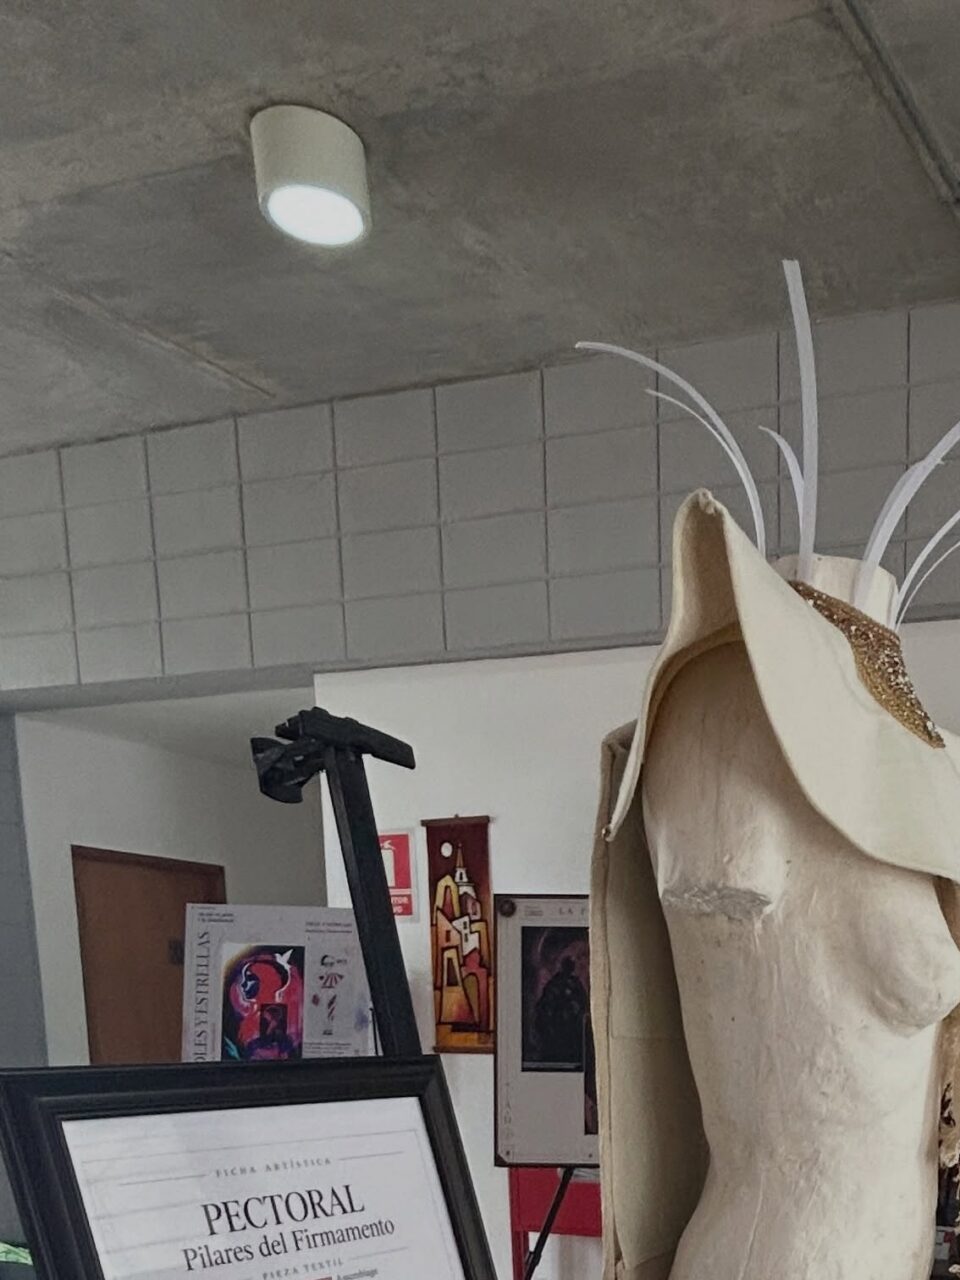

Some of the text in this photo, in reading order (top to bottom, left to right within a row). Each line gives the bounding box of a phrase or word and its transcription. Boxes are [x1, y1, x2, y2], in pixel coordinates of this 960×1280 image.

[215, 1158, 332, 1179] FICHA ARTÍSTICA
[201, 1184, 366, 1237] PECTORAL
[181, 1219, 396, 1272] Pilares del Firmamento
[262, 1258, 345, 1280] PIEZA TEXTIL
